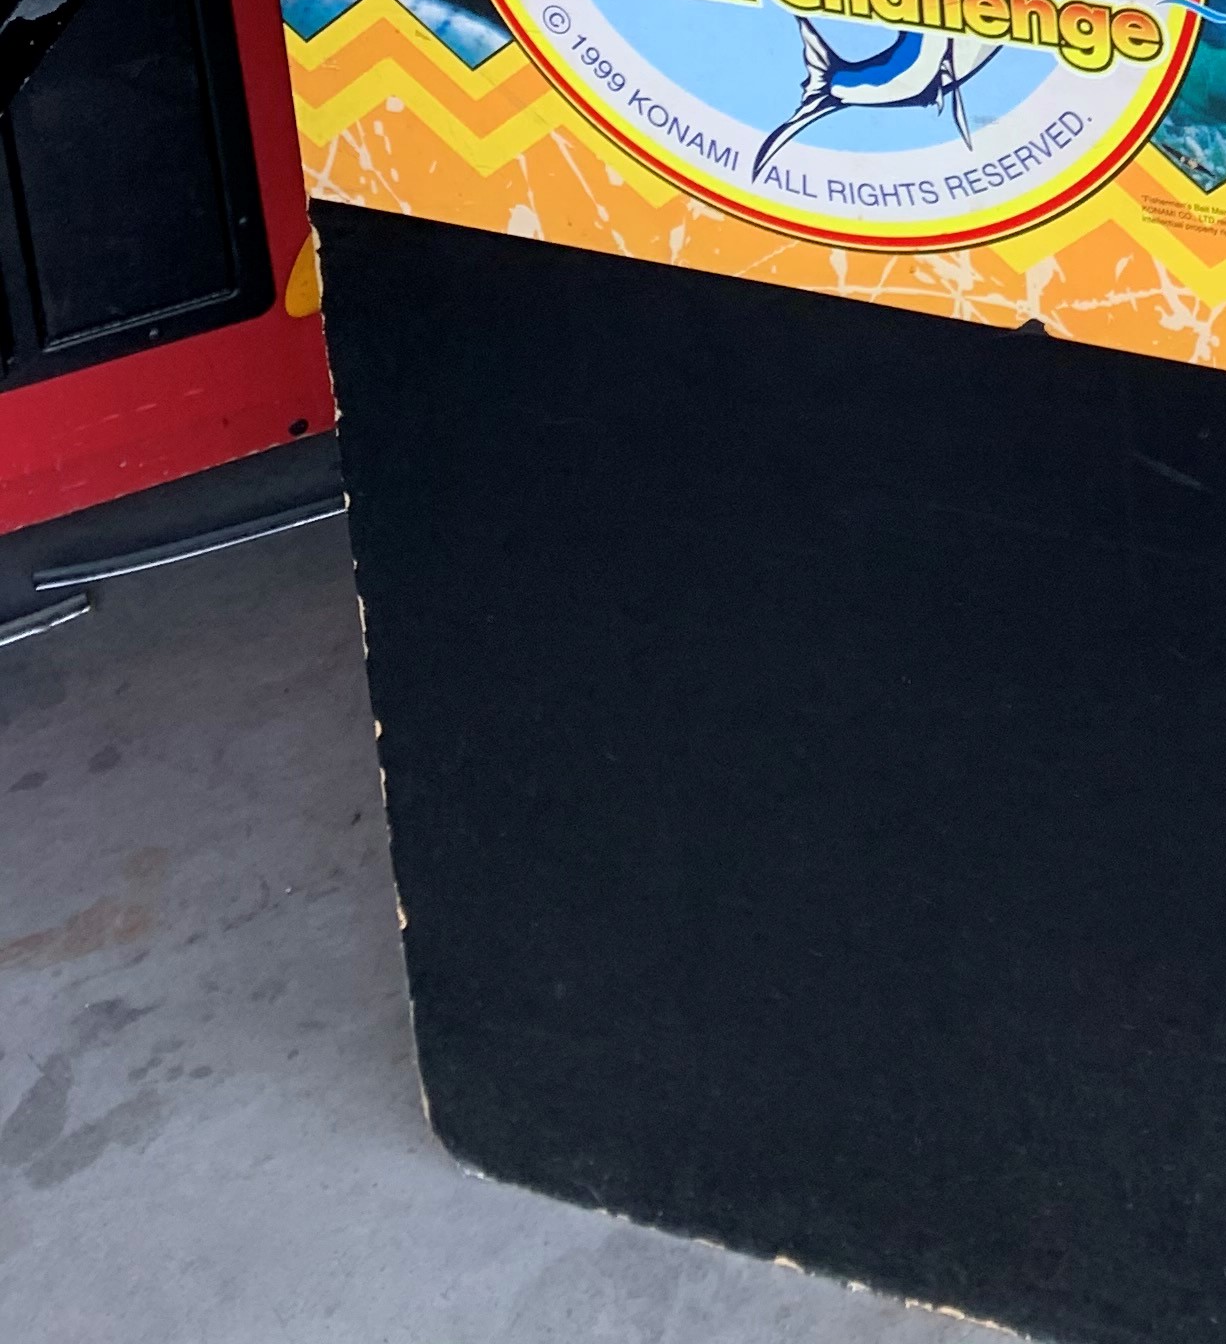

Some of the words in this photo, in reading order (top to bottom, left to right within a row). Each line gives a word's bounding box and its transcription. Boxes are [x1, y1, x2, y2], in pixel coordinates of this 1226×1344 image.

[570, 34, 627, 94] 1999
[627, 89, 741, 173] KONAMI
[763, 165, 819, 199] ALL
[827, 180, 940, 209] RIGHTS
[948, 109, 1094, 203] RESERVED.
[1141, 204, 1177, 217] KONAMI
